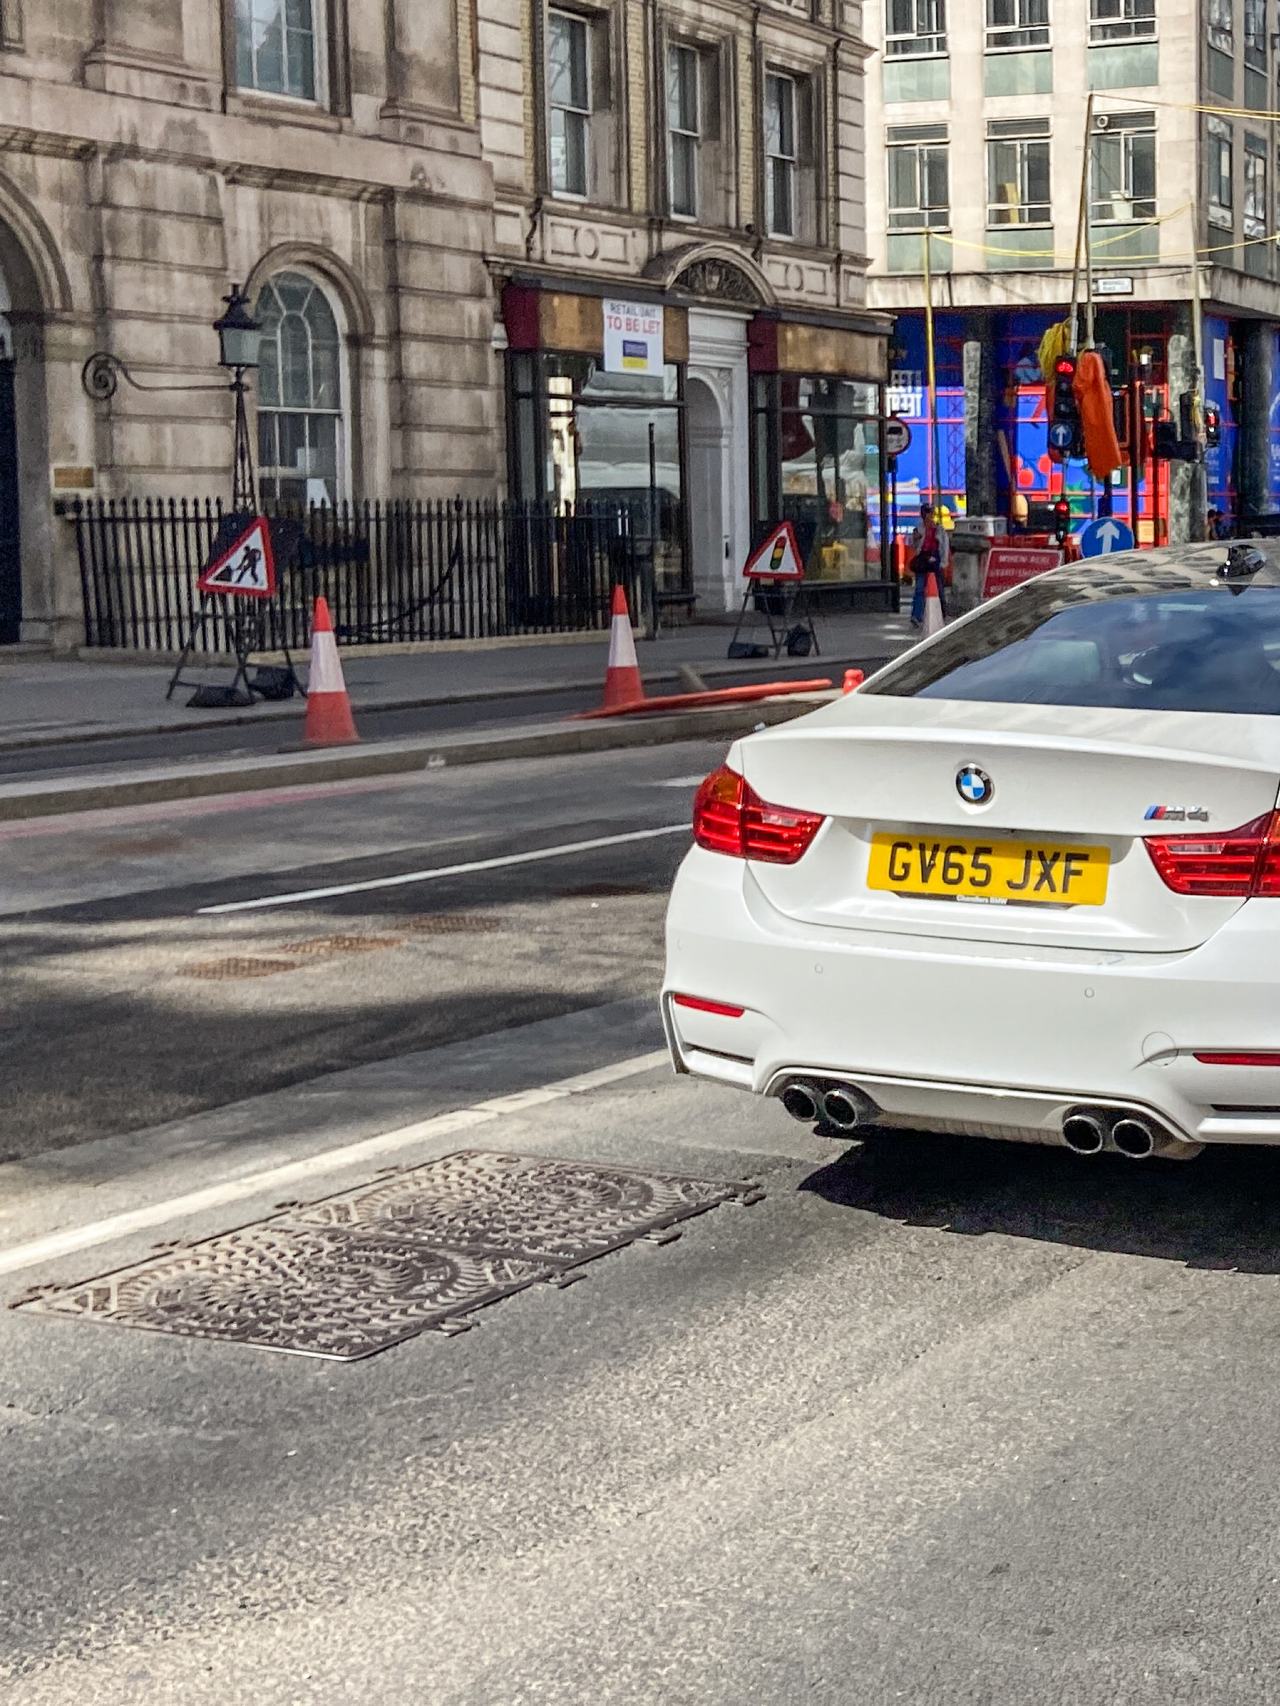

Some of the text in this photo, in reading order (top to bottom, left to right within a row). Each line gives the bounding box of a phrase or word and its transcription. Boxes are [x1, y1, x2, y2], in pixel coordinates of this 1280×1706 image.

[606, 315, 661, 335] TO BE LET
[888, 841, 1090, 894] GV65 JXF
